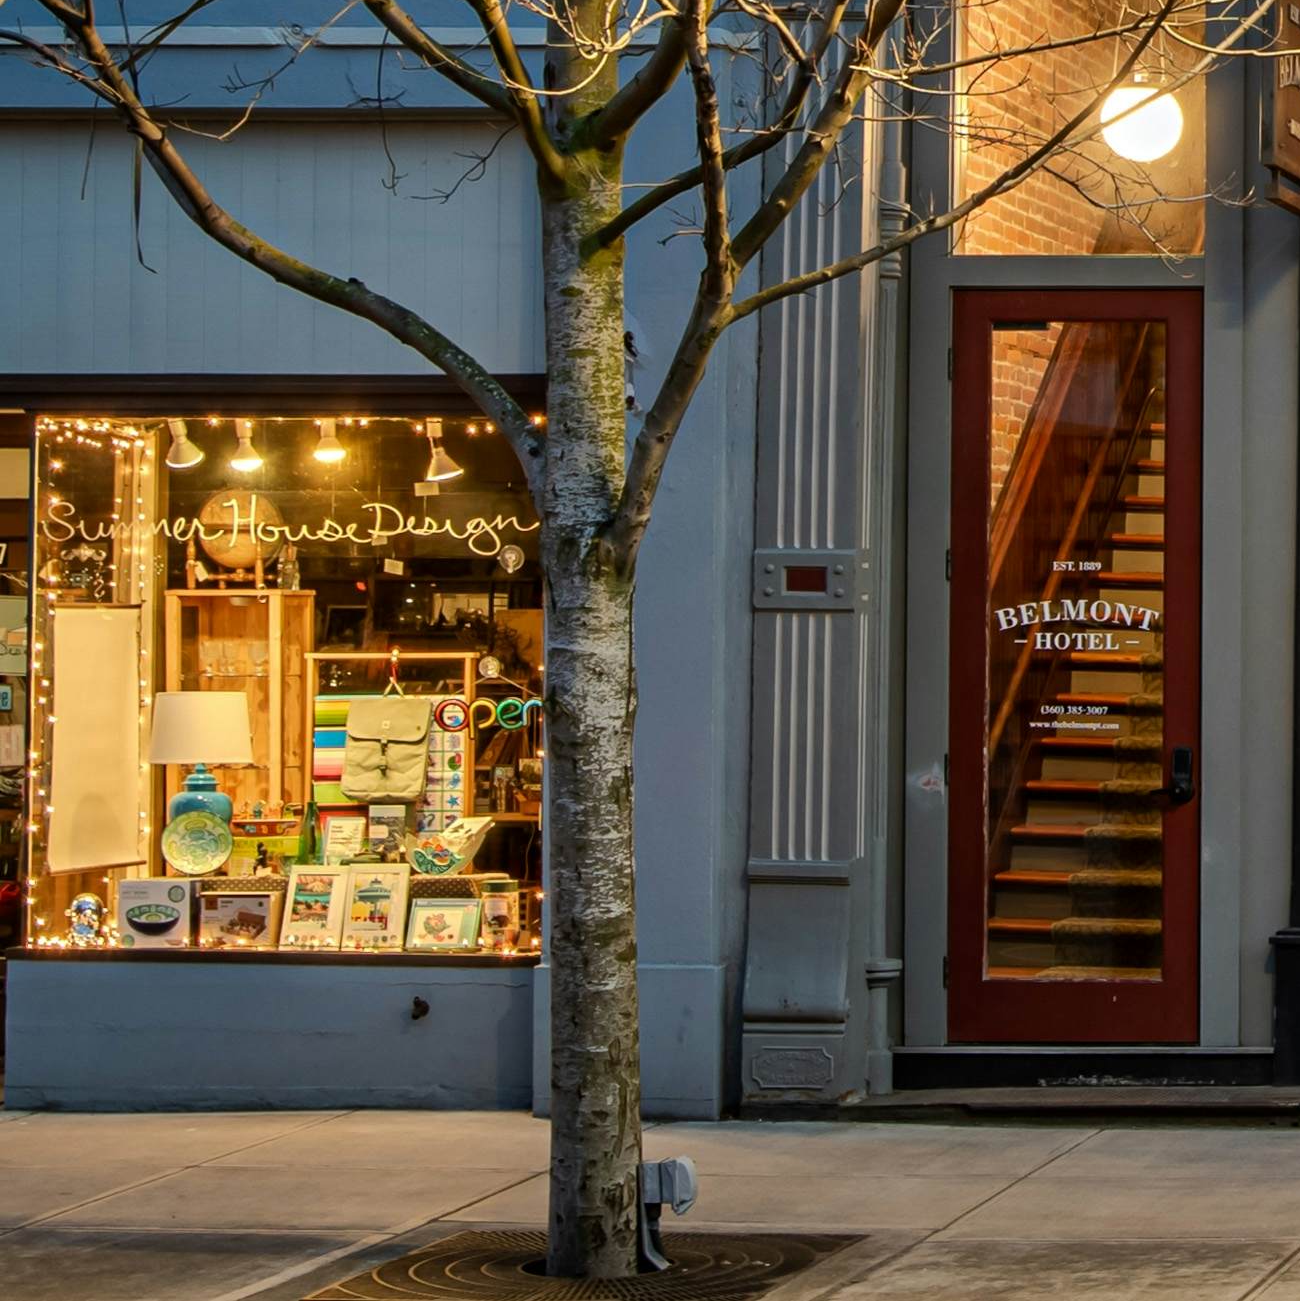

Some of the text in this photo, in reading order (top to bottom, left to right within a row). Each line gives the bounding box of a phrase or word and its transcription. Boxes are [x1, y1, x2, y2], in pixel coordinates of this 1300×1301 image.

[222, 494, 372, 546] House
[361, 503, 540, 556] Design
[994, 599, 1160, 632] BELMONT
[1034, 632, 1120, 650] HOTEL
